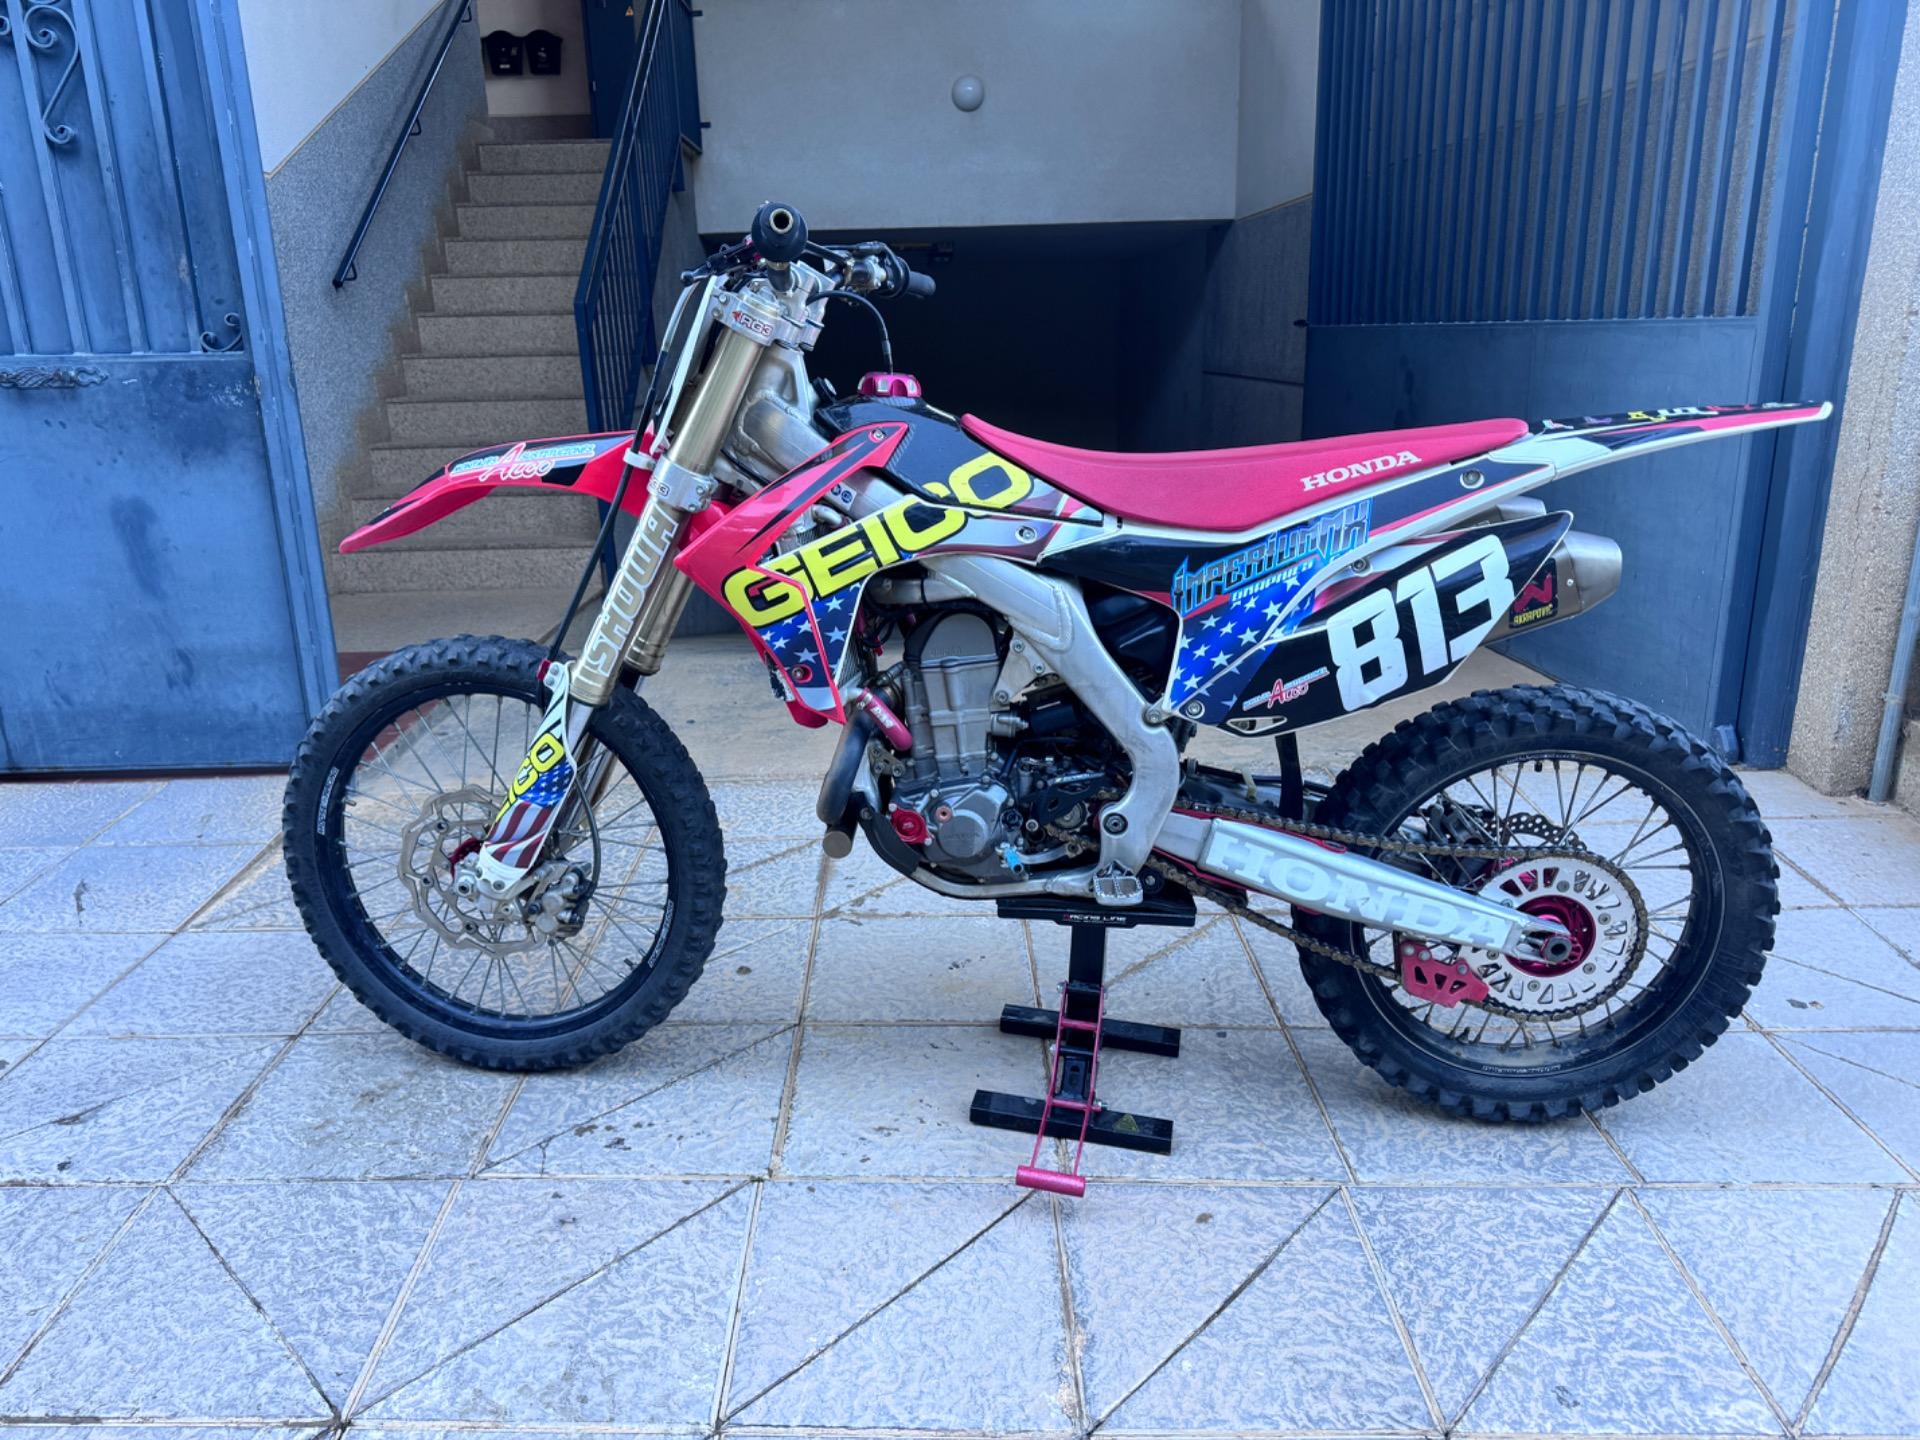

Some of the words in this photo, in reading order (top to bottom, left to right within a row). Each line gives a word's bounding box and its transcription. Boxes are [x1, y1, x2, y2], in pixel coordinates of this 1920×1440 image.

[722, 451, 1033, 628] GEICO
[1300, 450, 1422, 491] HONDA
[585, 503, 679, 677] SHOWA
[1326, 534, 1515, 711] 813
[1206, 834, 1506, 949] HONDA
